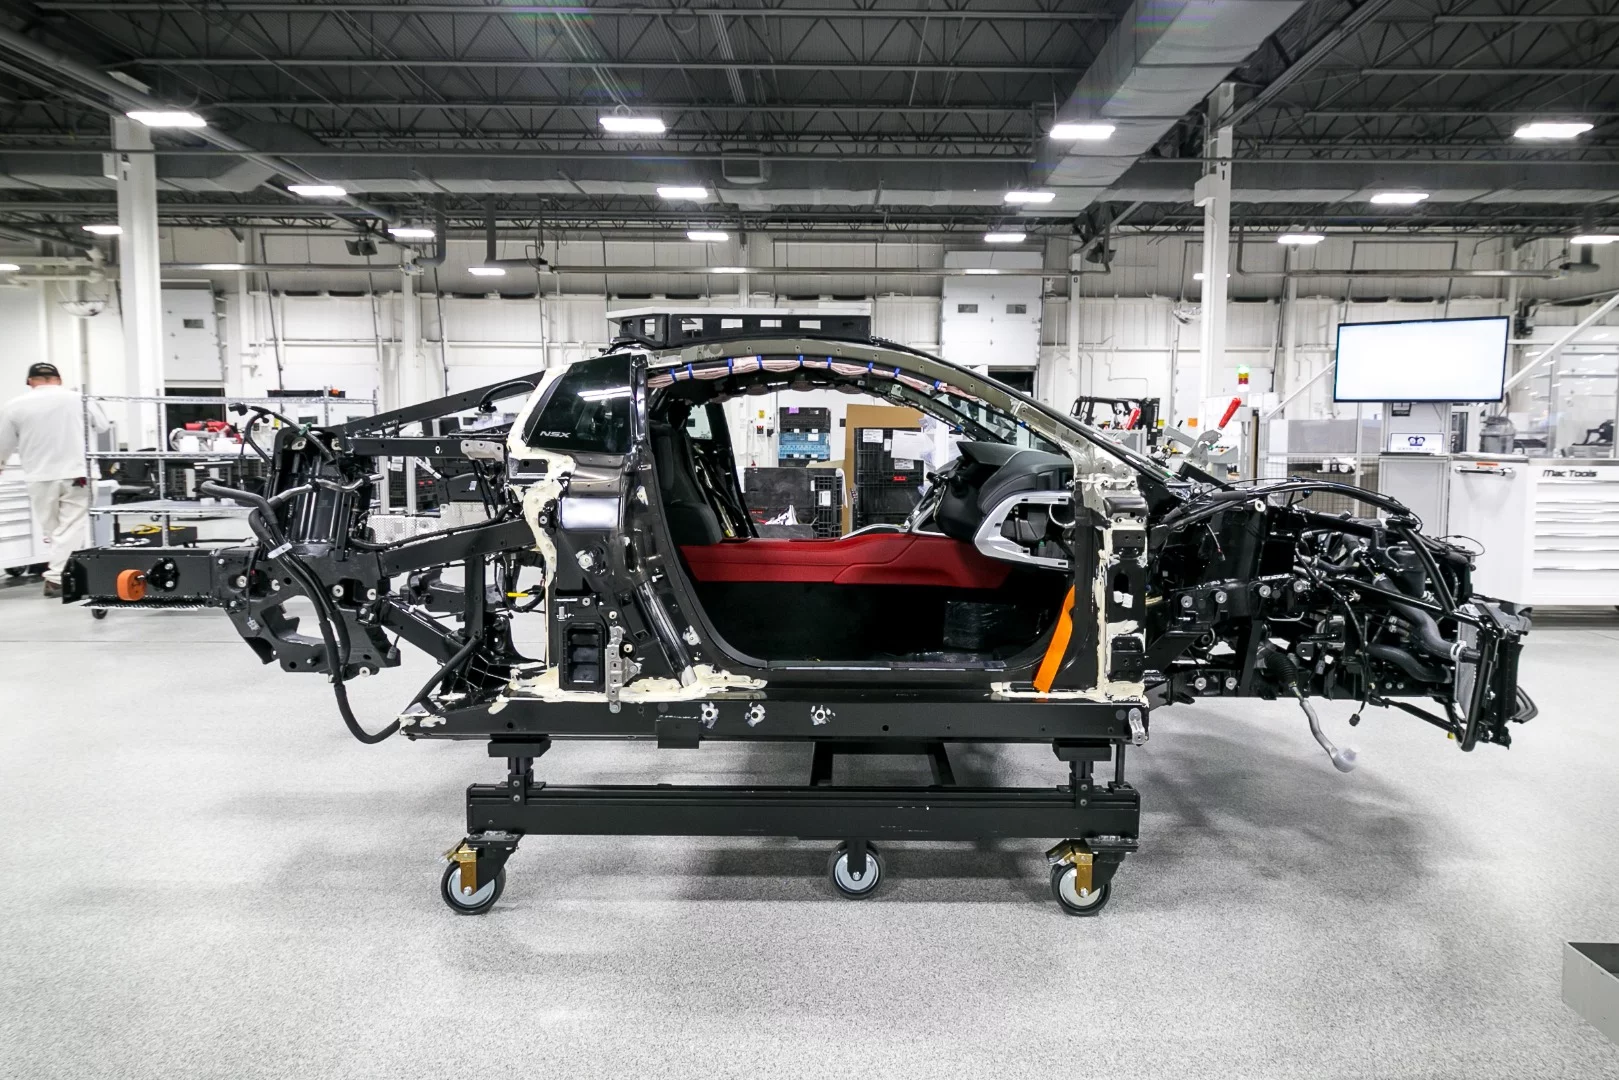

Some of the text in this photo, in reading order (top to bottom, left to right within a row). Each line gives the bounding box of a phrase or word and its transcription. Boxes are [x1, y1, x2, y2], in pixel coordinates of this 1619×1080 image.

[540, 430, 571, 438] NSX
[1542, 469, 1597, 478] Mac Tools
